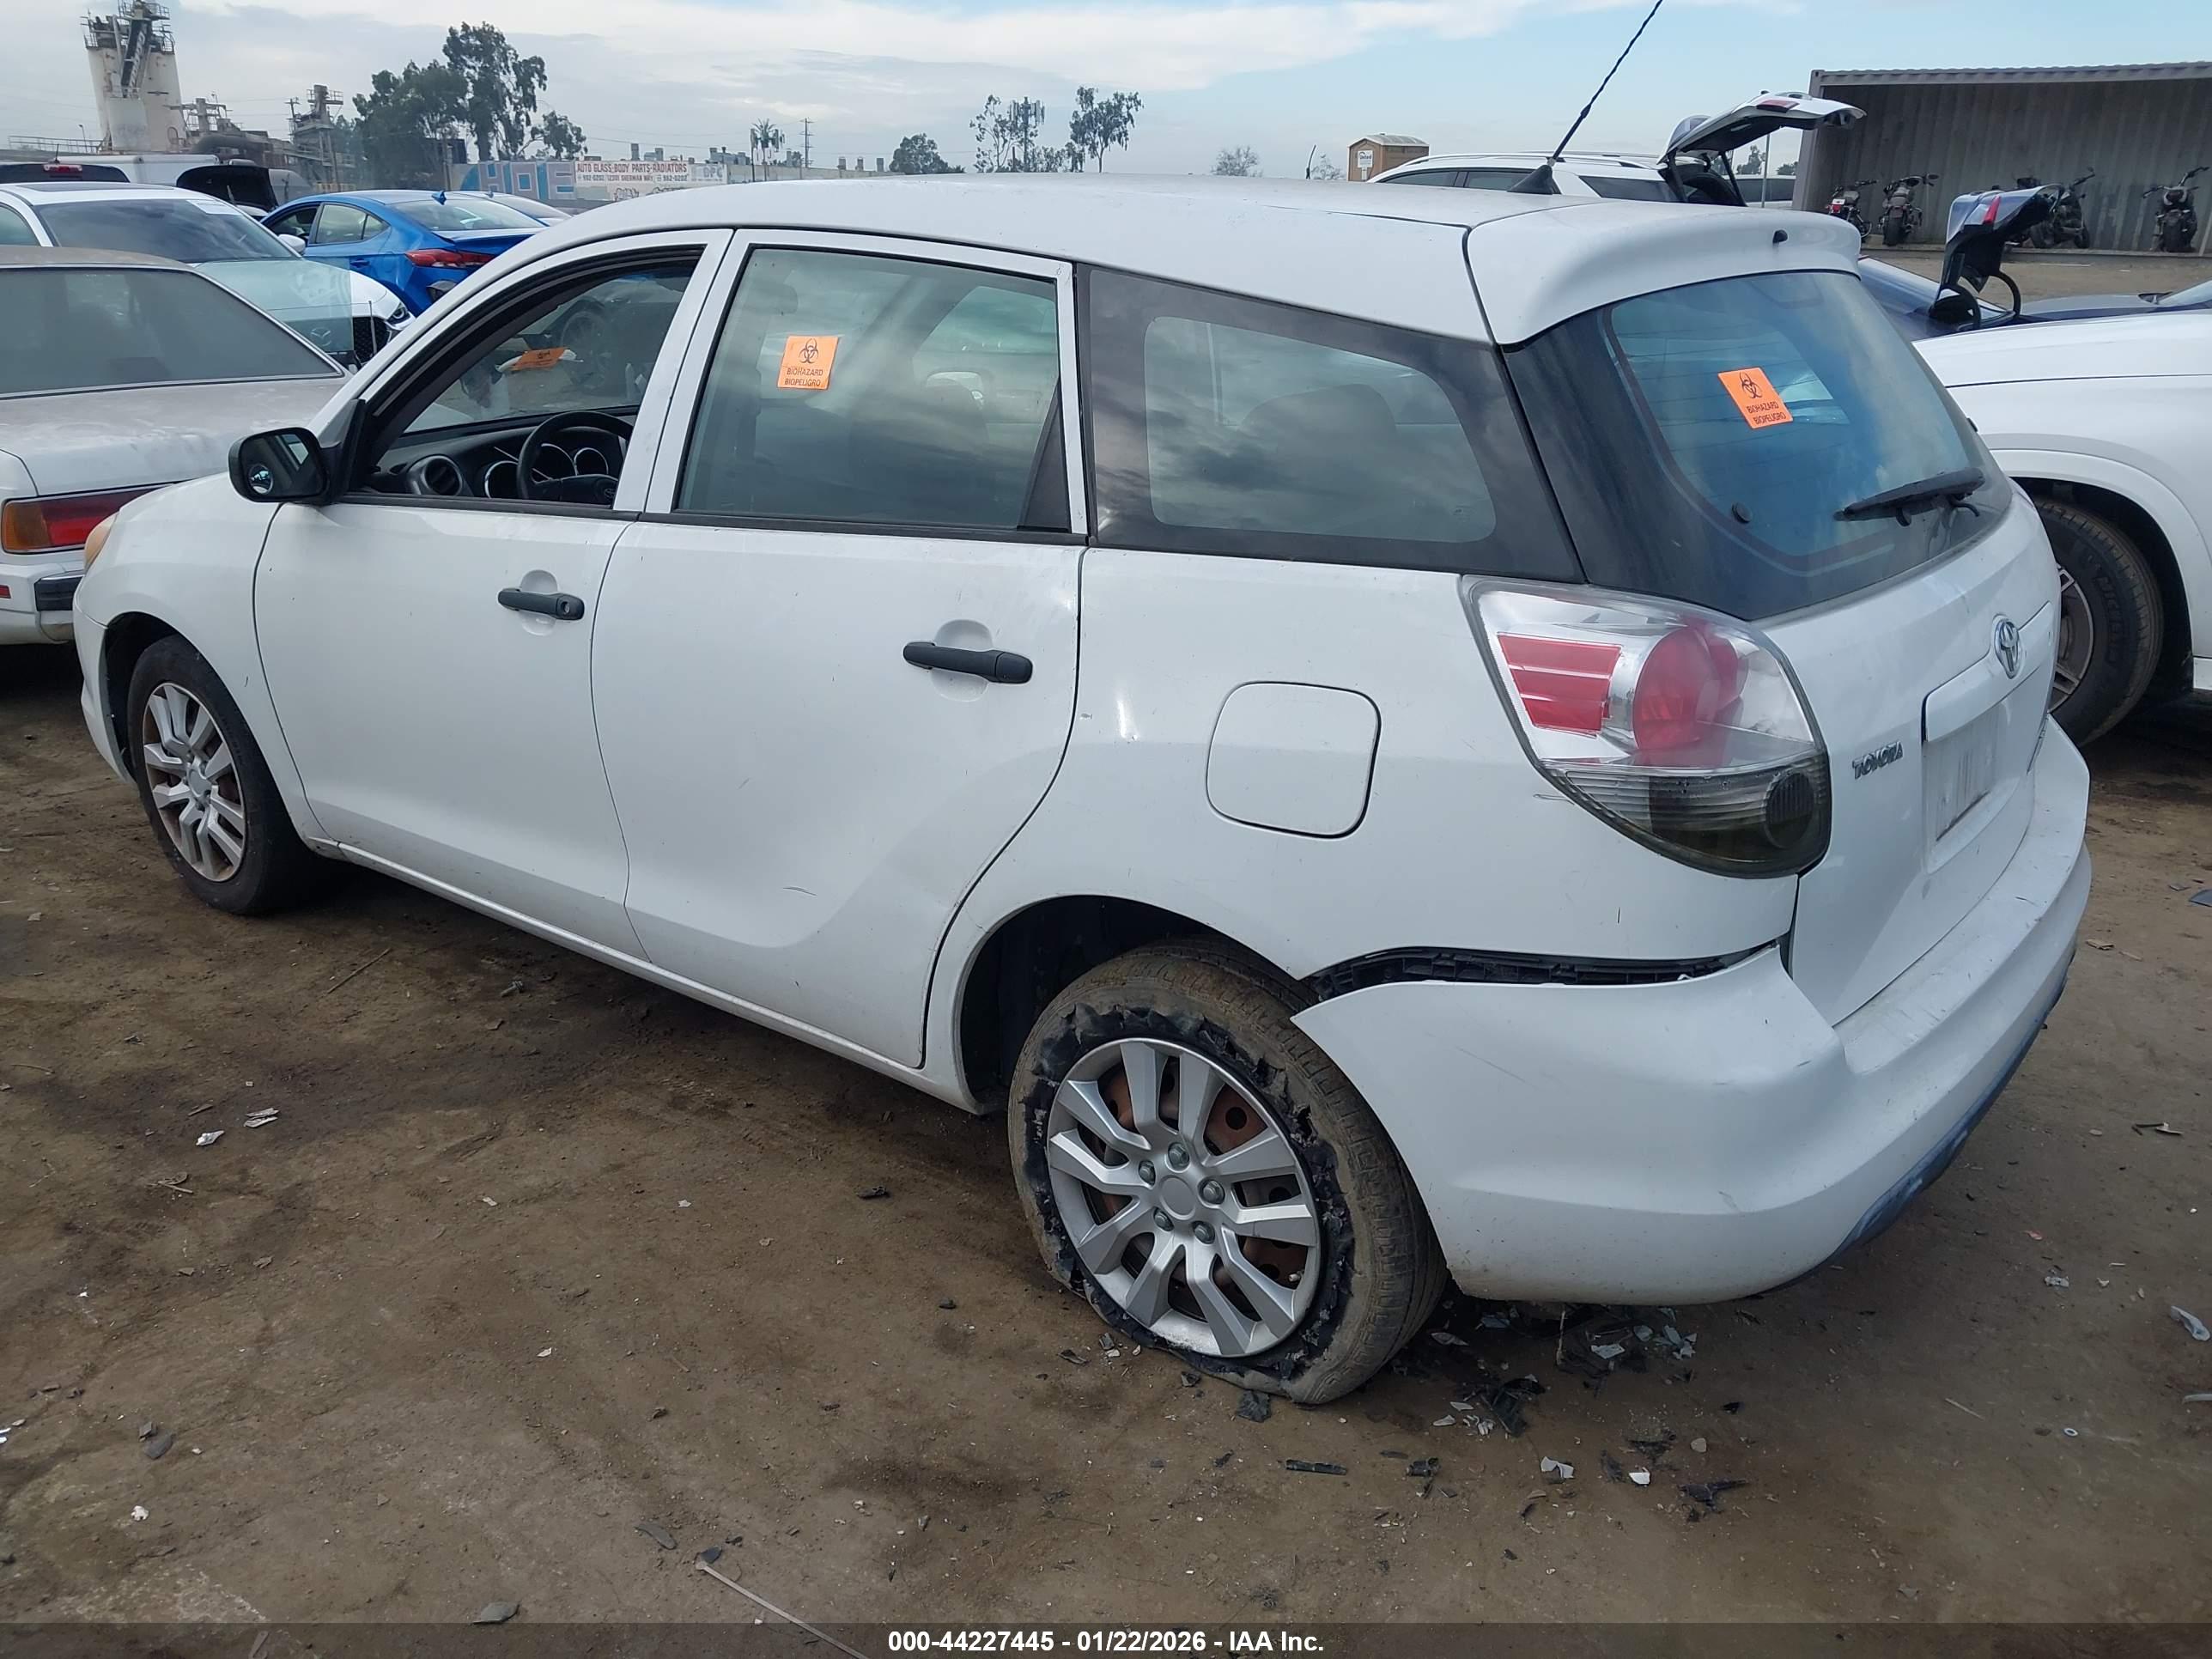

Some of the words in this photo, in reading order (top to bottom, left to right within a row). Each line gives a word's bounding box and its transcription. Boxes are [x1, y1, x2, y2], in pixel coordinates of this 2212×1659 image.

[577, 163, 592, 173] AUTO
[787, 368, 823, 376] BIOHAZARD
[784, 378, 821, 386] BIOPELIGRO
[1747, 401, 1779, 413] BIOHAZARD
[1753, 412, 1786, 425] BIOPELIGRO
[1852, 741, 1904, 780] TOYOTA
